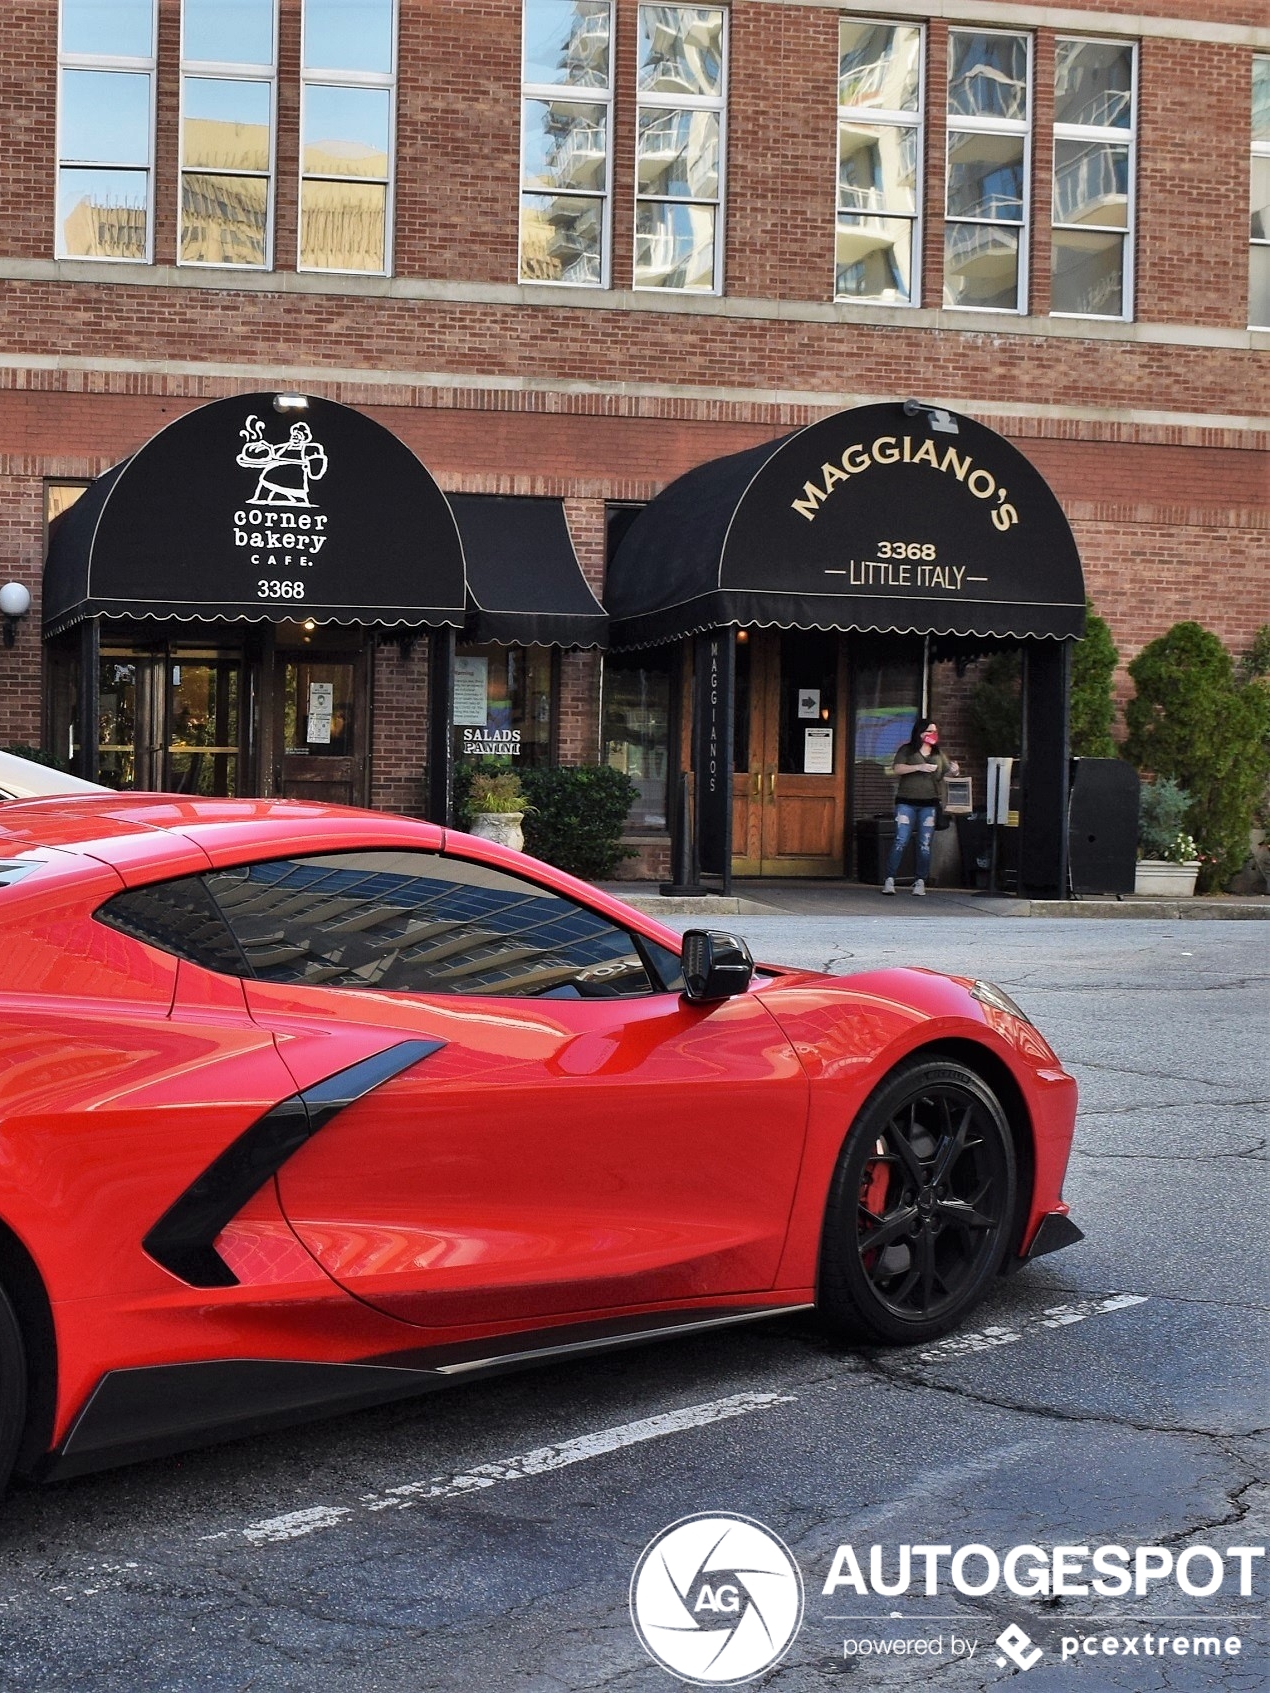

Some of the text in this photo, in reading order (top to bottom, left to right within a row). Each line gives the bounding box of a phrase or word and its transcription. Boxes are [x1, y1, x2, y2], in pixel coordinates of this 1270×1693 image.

[790, 435, 1019, 531] MAGGIANO'S
[233, 509, 328, 531] corner
[233, 527, 327, 554] bakery
[877, 541, 936, 561] 3368
[850, 560, 966, 590] LITTLE ITALY
[257, 579, 305, 599] 3368
[463, 728, 521, 742] SALADS
[463, 741, 521, 755] PANINI
